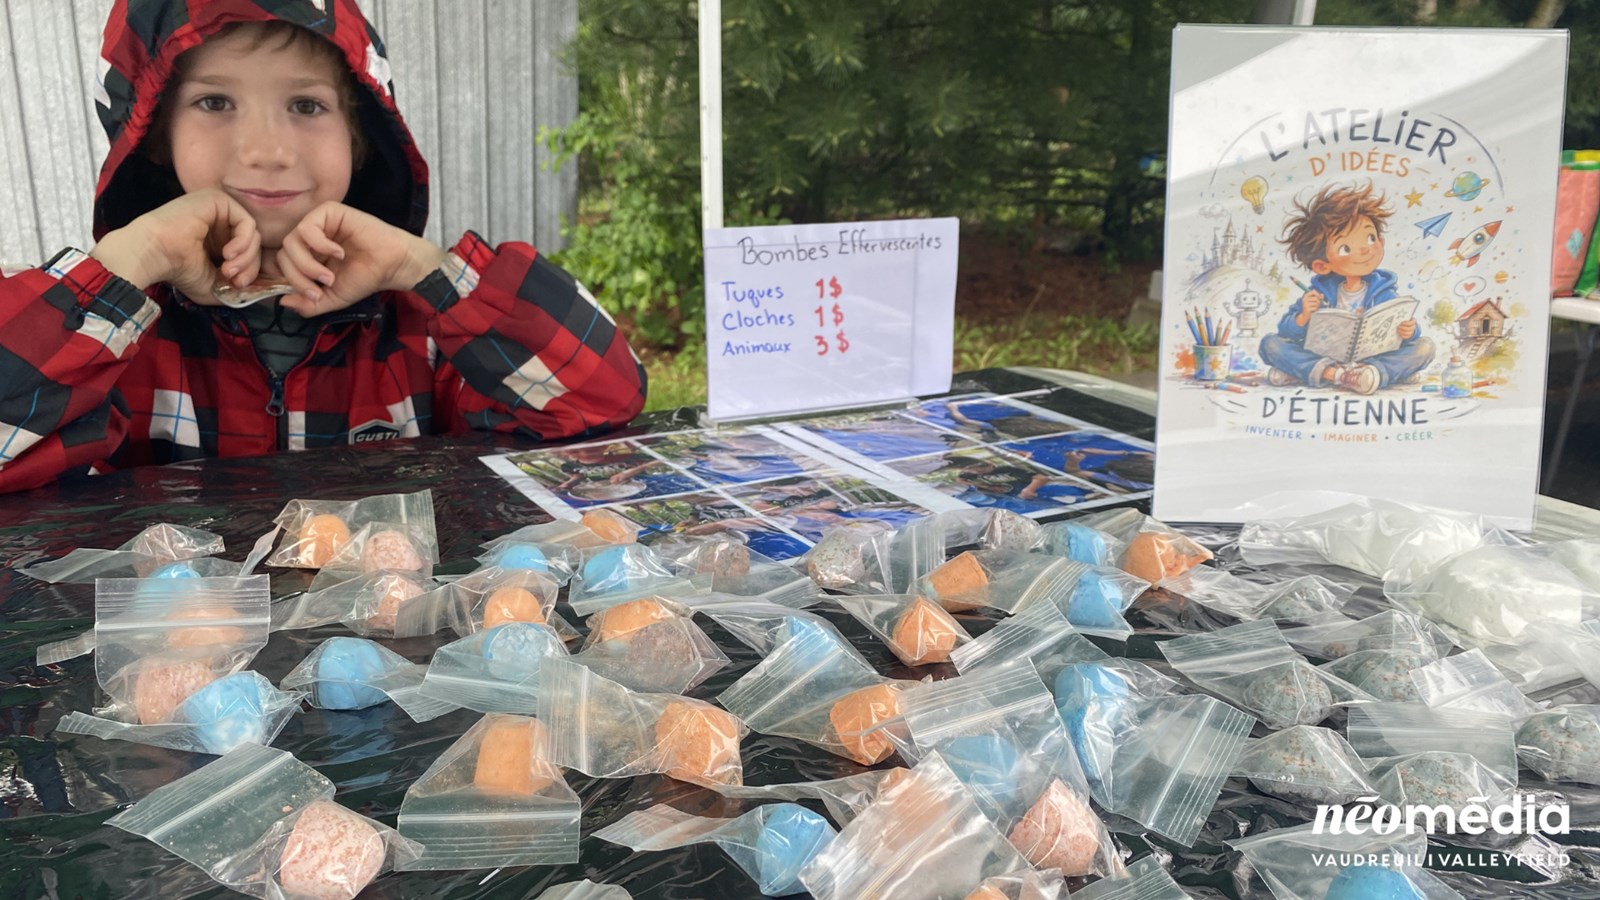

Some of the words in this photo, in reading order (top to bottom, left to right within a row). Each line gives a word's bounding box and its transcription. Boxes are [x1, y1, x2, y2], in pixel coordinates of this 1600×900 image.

[738, 235, 829, 266] Bombes
[838, 228, 942, 255] Effervescentes
[721, 281, 784, 308] Tuques
[722, 308, 795, 331] Cloches
[722, 340, 791, 357] Animaux
[1245, 425, 1302, 440] INVENTER
[1323, 432, 1378, 443] IMAGINER
[1396, 430, 1433, 442] CRÉER
